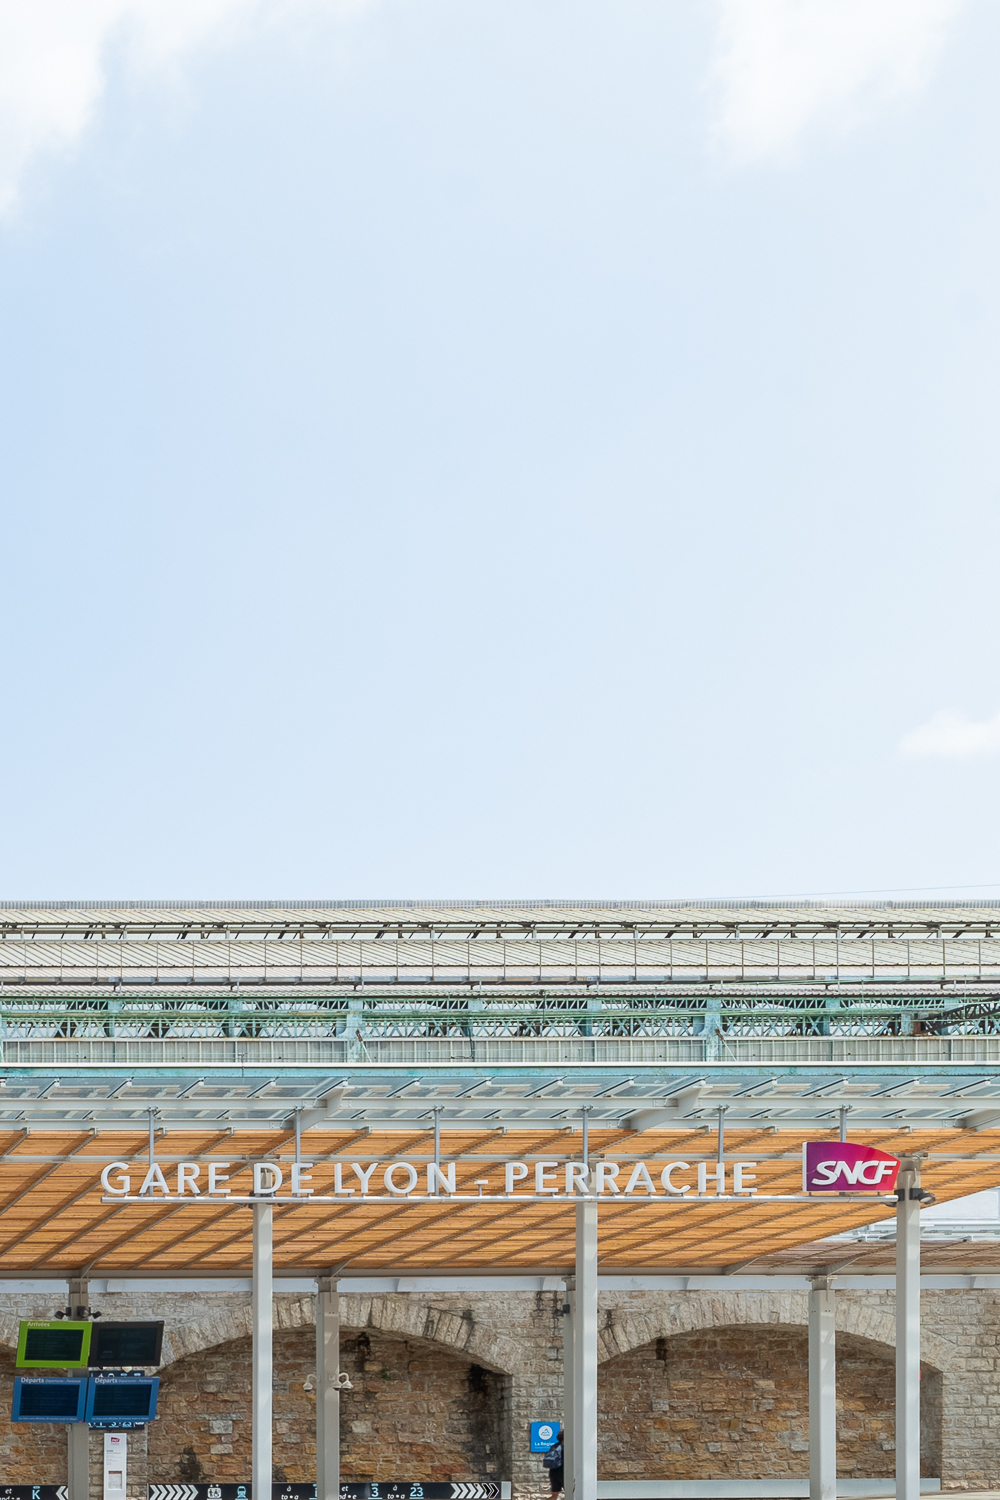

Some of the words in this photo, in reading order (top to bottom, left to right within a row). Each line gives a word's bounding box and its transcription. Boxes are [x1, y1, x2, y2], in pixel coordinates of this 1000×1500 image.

[100, 1161, 231, 1195] GARE
[253, 1162, 314, 1195] DE
[334, 1161, 456, 1195] LYON
[505, 1161, 758, 1194] PERRACHE
[811, 1160, 898, 1186] SNCF
[32, 1490, 41, 1500] K
[372, 1487, 379, 1497] 3
[410, 1487, 423, 1497] 23
